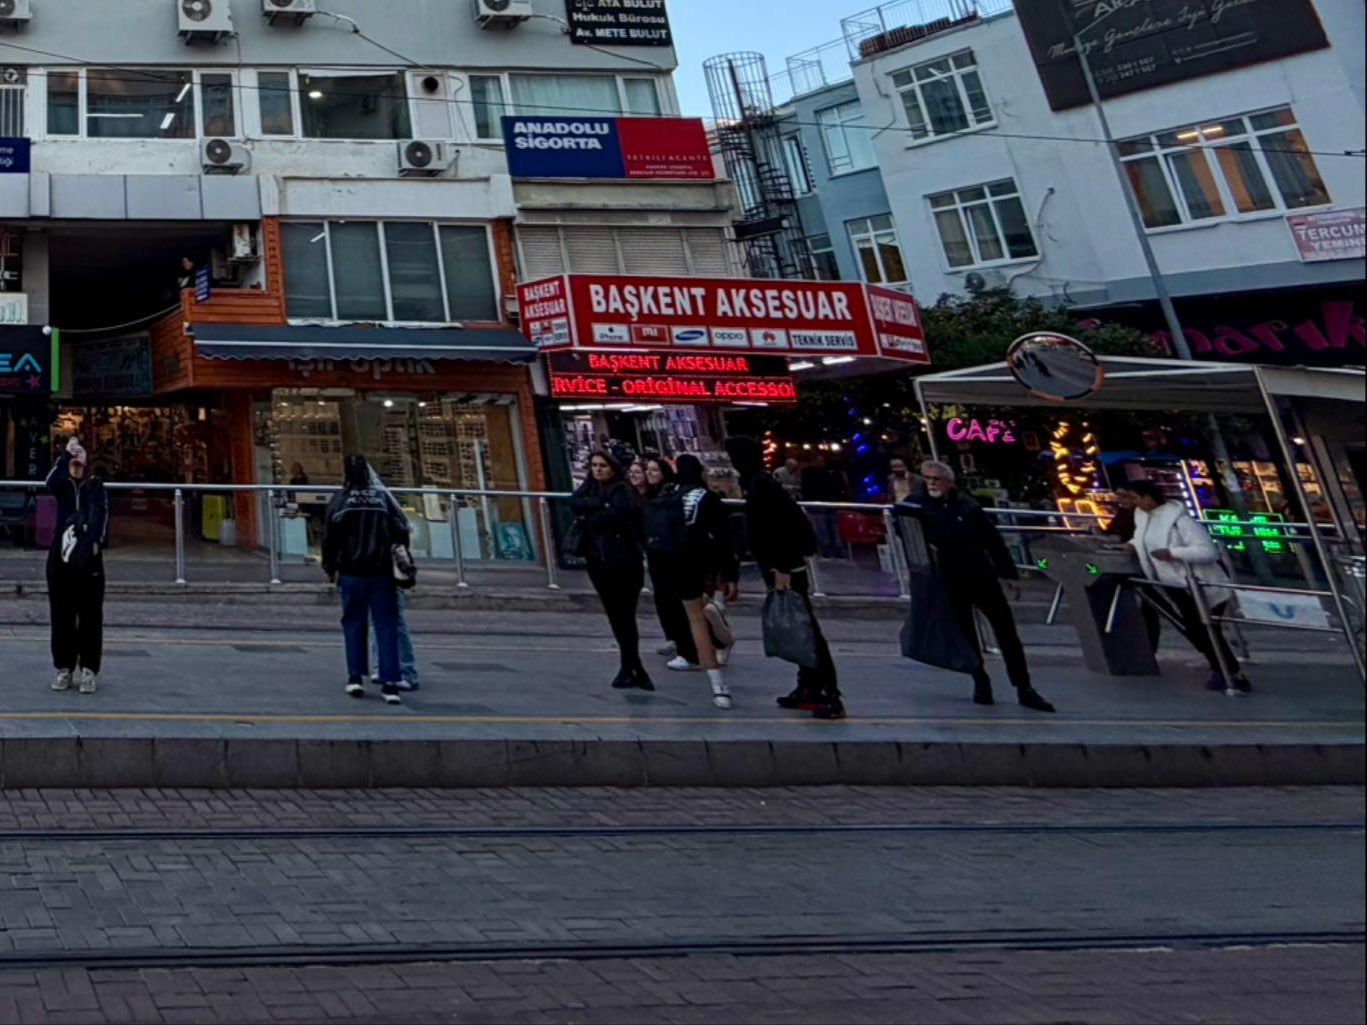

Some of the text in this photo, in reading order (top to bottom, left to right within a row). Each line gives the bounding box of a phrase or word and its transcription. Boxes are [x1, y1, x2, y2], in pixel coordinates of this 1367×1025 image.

[572, 12, 666, 24] Hukuk Bürosu
[576, 27, 668, 39] Av. METE BULUT
[513, 121, 610, 135] ANADOLU
[514, 133, 603, 150] SİGORTA
[589, 283, 853, 322] BAŞKENT AKSESUAR
[714, 331, 744, 341] oppo
[792, 332, 855, 347] TEKNİK SERVİS
[589, 354, 750, 373] BAŞKENT AKSESUAR
[622, 376, 711, 395] ORİGİNAL
